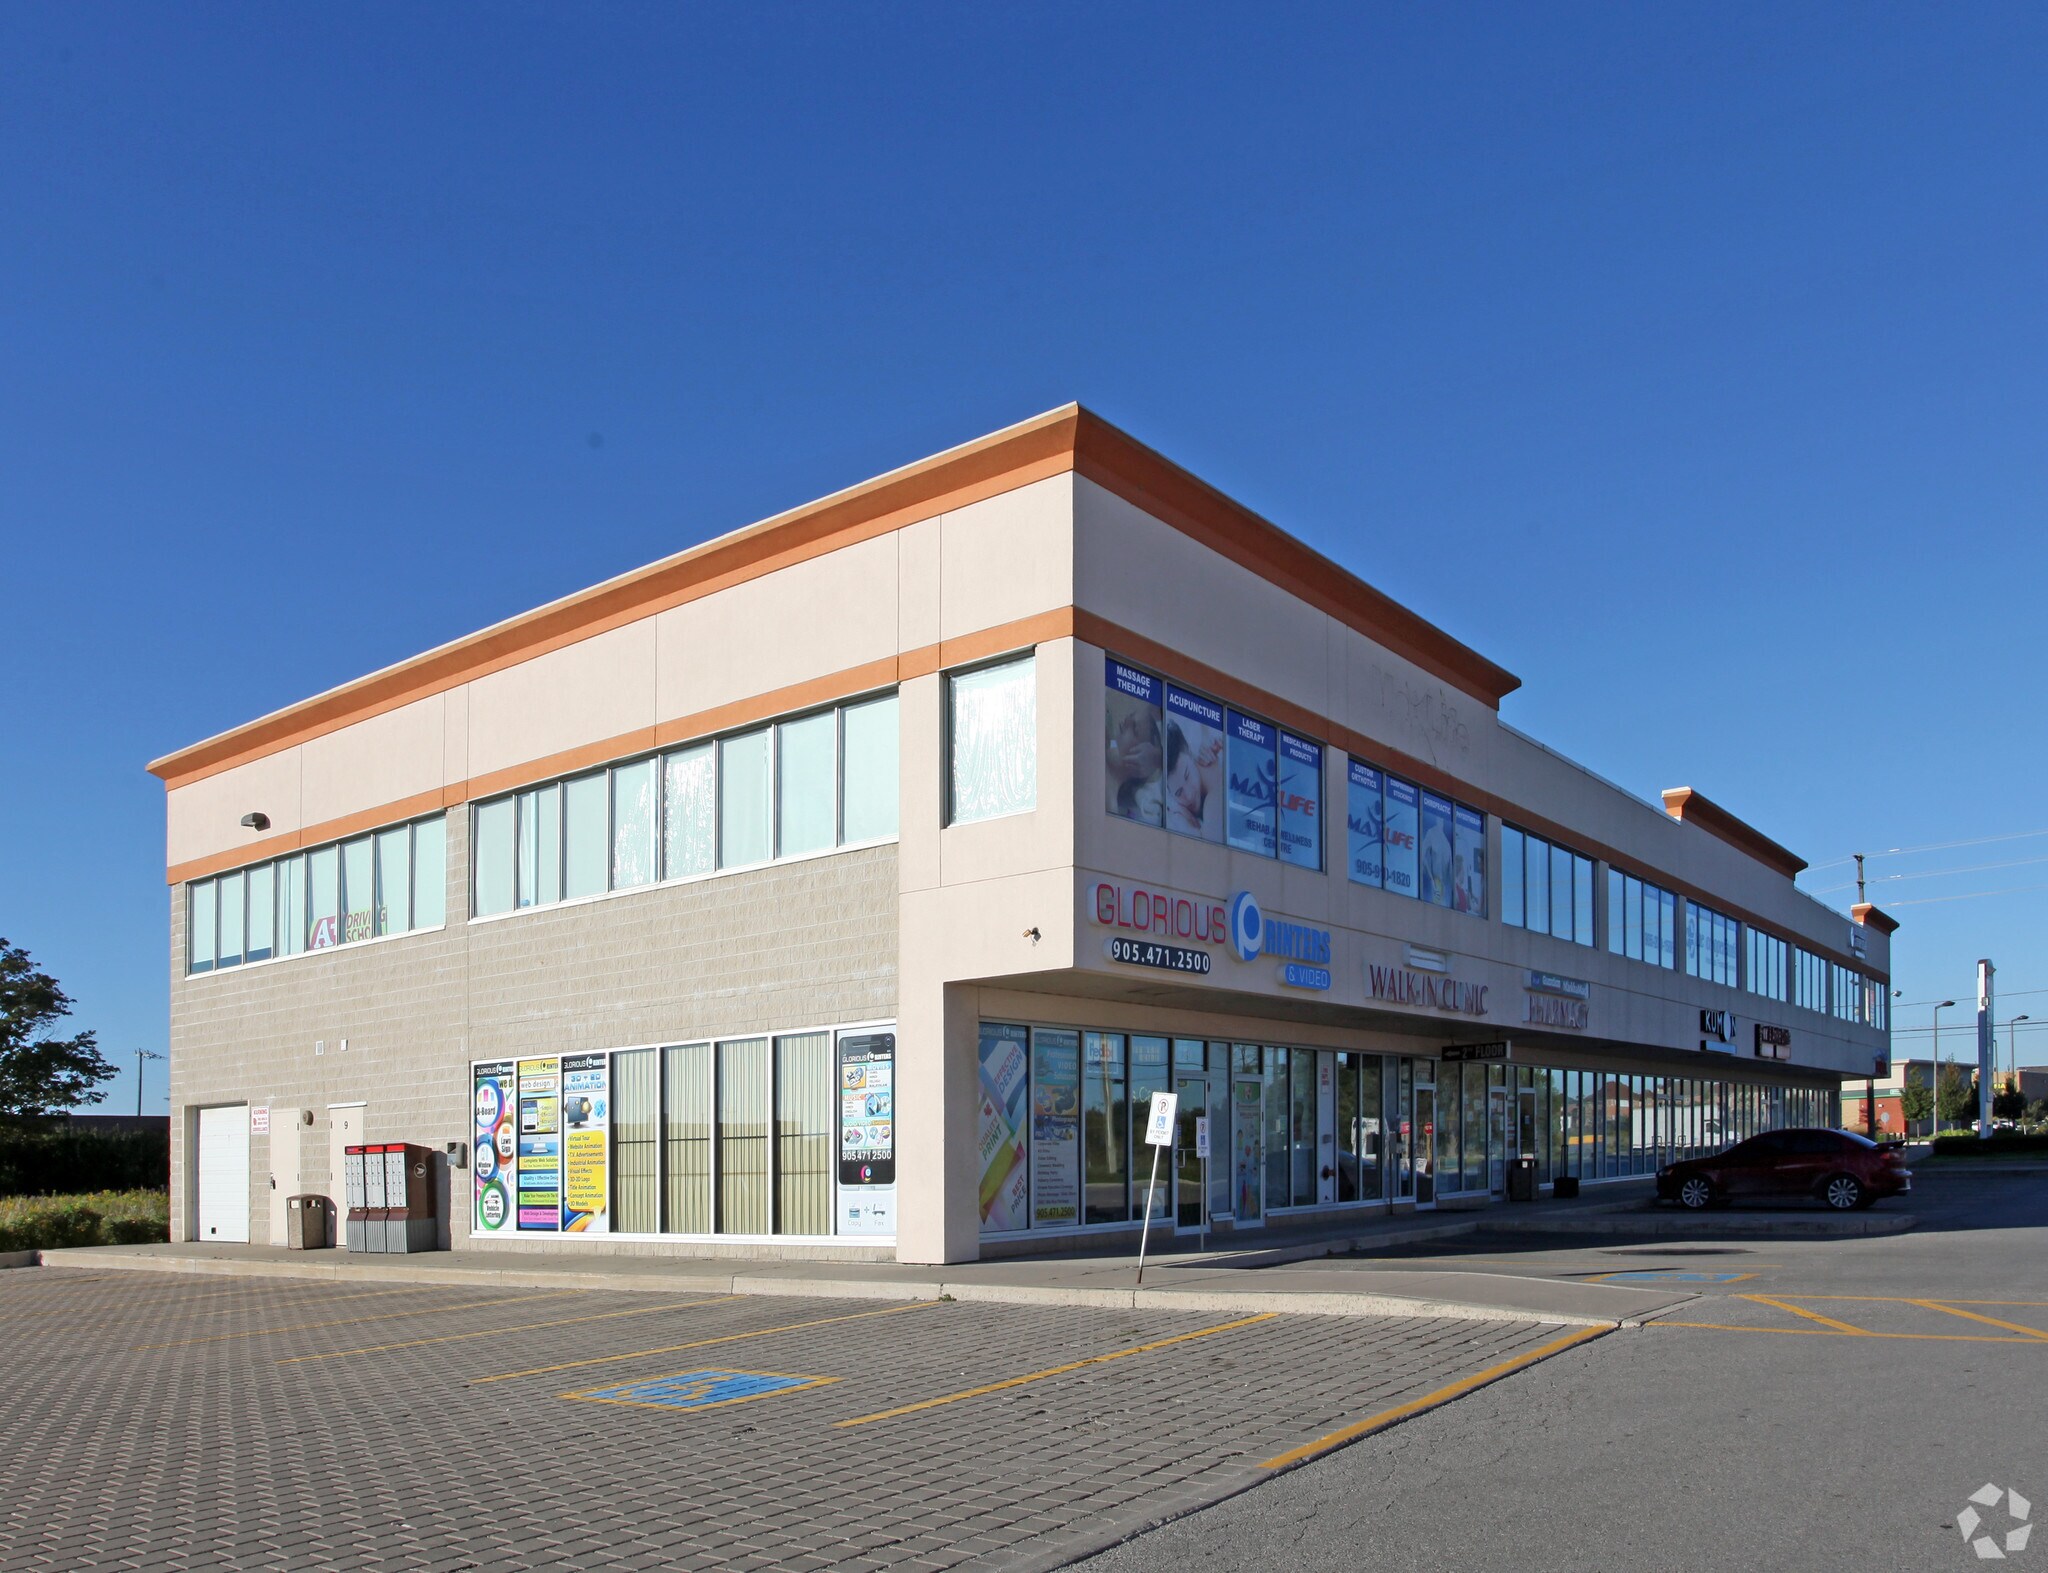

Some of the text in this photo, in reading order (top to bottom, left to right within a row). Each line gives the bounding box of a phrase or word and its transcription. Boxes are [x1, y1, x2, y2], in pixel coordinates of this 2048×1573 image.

[1116, 665, 1151, 688] MASSAGE
[1117, 678, 1151, 699] THERAPY
[1169, 693, 1221, 722] ACUPUNCTURE
[1242, 717, 1261, 732] LASER
[1238, 727, 1265, 744] THERAPY
[1282, 735, 1319, 754] MEDICAL HEALTH
[1289, 748, 1312, 763] PRODUCTS
[1351, 772, 1377, 789] ORTHOTICS
[1354, 763, 1374, 778] CUSTOM
[1423, 797, 1451, 815] CHIROPRACTIC
[1246, 819, 1270, 836] REHAB
[1356, 859, 1411, 888] 905-9-1820
[346, 906, 386, 930] DRIVIG
[1096, 883, 1331, 965] GLORIOUS PRINTERS
[1112, 940, 1210, 972] 905.471.2500
[1288, 965, 1328, 987] & VIDEO
[1440, 977, 1489, 1015] CLINIC
[1526, 993, 1590, 1030] PHARMACY
[1705, 1010, 1737, 1042] KUMON
[1475, 1043, 1505, 1058] FLOOR
[994, 1044, 1018, 1085] EFFECTIVE
[999, 1050, 1023, 1095] DESIGN
[1058, 1060, 1077, 1070] VIDEO
[499, 1080, 508, 1088] we
[521, 1079, 551, 1089] web design
[564, 1081, 606, 1091] ANIMATION
[476, 1106, 496, 1116] A-Board
[344, 1120, 348, 1130] 9
[978, 1116, 998, 1151] QUALITY
[982, 1124, 1002, 1161] PRINT
[842, 1150, 892, 1162] 905.471.2500
[1012, 1174, 1025, 1196] BEST
[1010, 1184, 1027, 1214] PRICE
[1036, 1206, 1076, 1218] 905.471.2500
